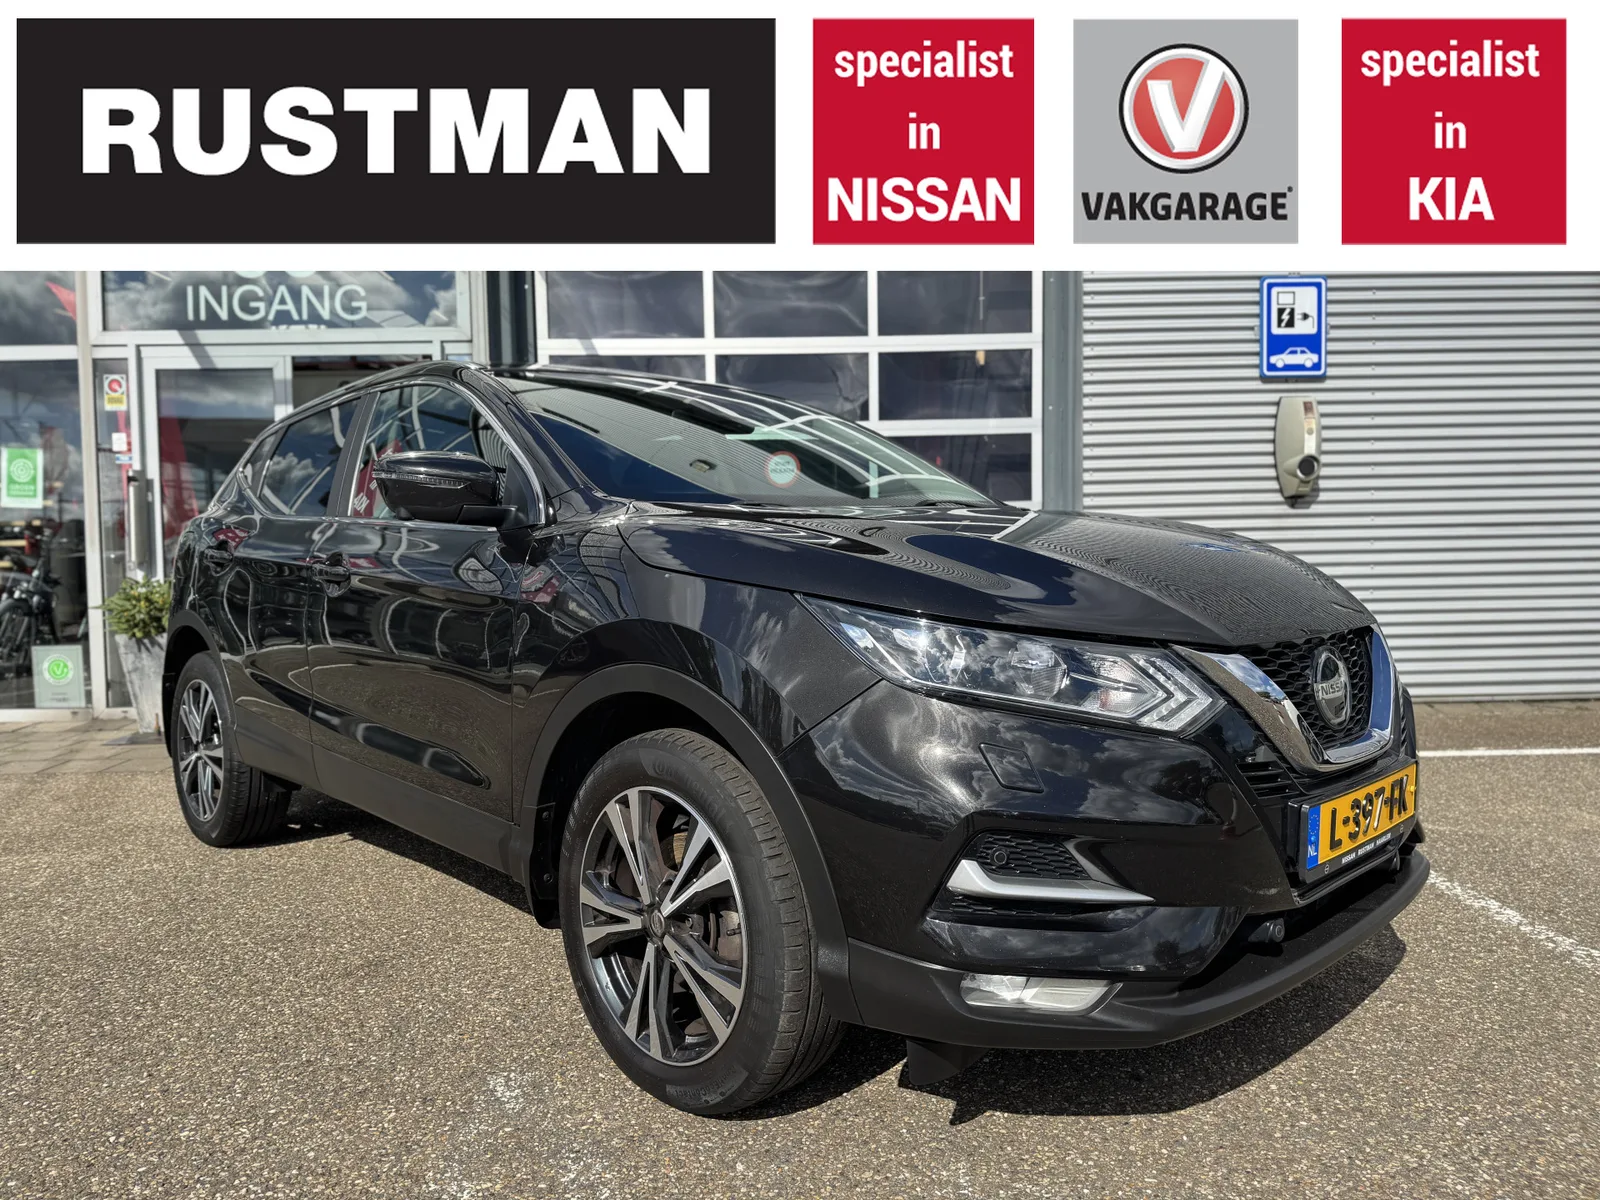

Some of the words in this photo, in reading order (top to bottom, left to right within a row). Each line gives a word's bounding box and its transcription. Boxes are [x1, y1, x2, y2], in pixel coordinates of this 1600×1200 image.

[186, 284, 368, 321] INGANG
[1320, 681, 1344, 697] NISS
[1329, 774, 1409, 852] L-397-FK
[1307, 843, 1318, 859] NL
